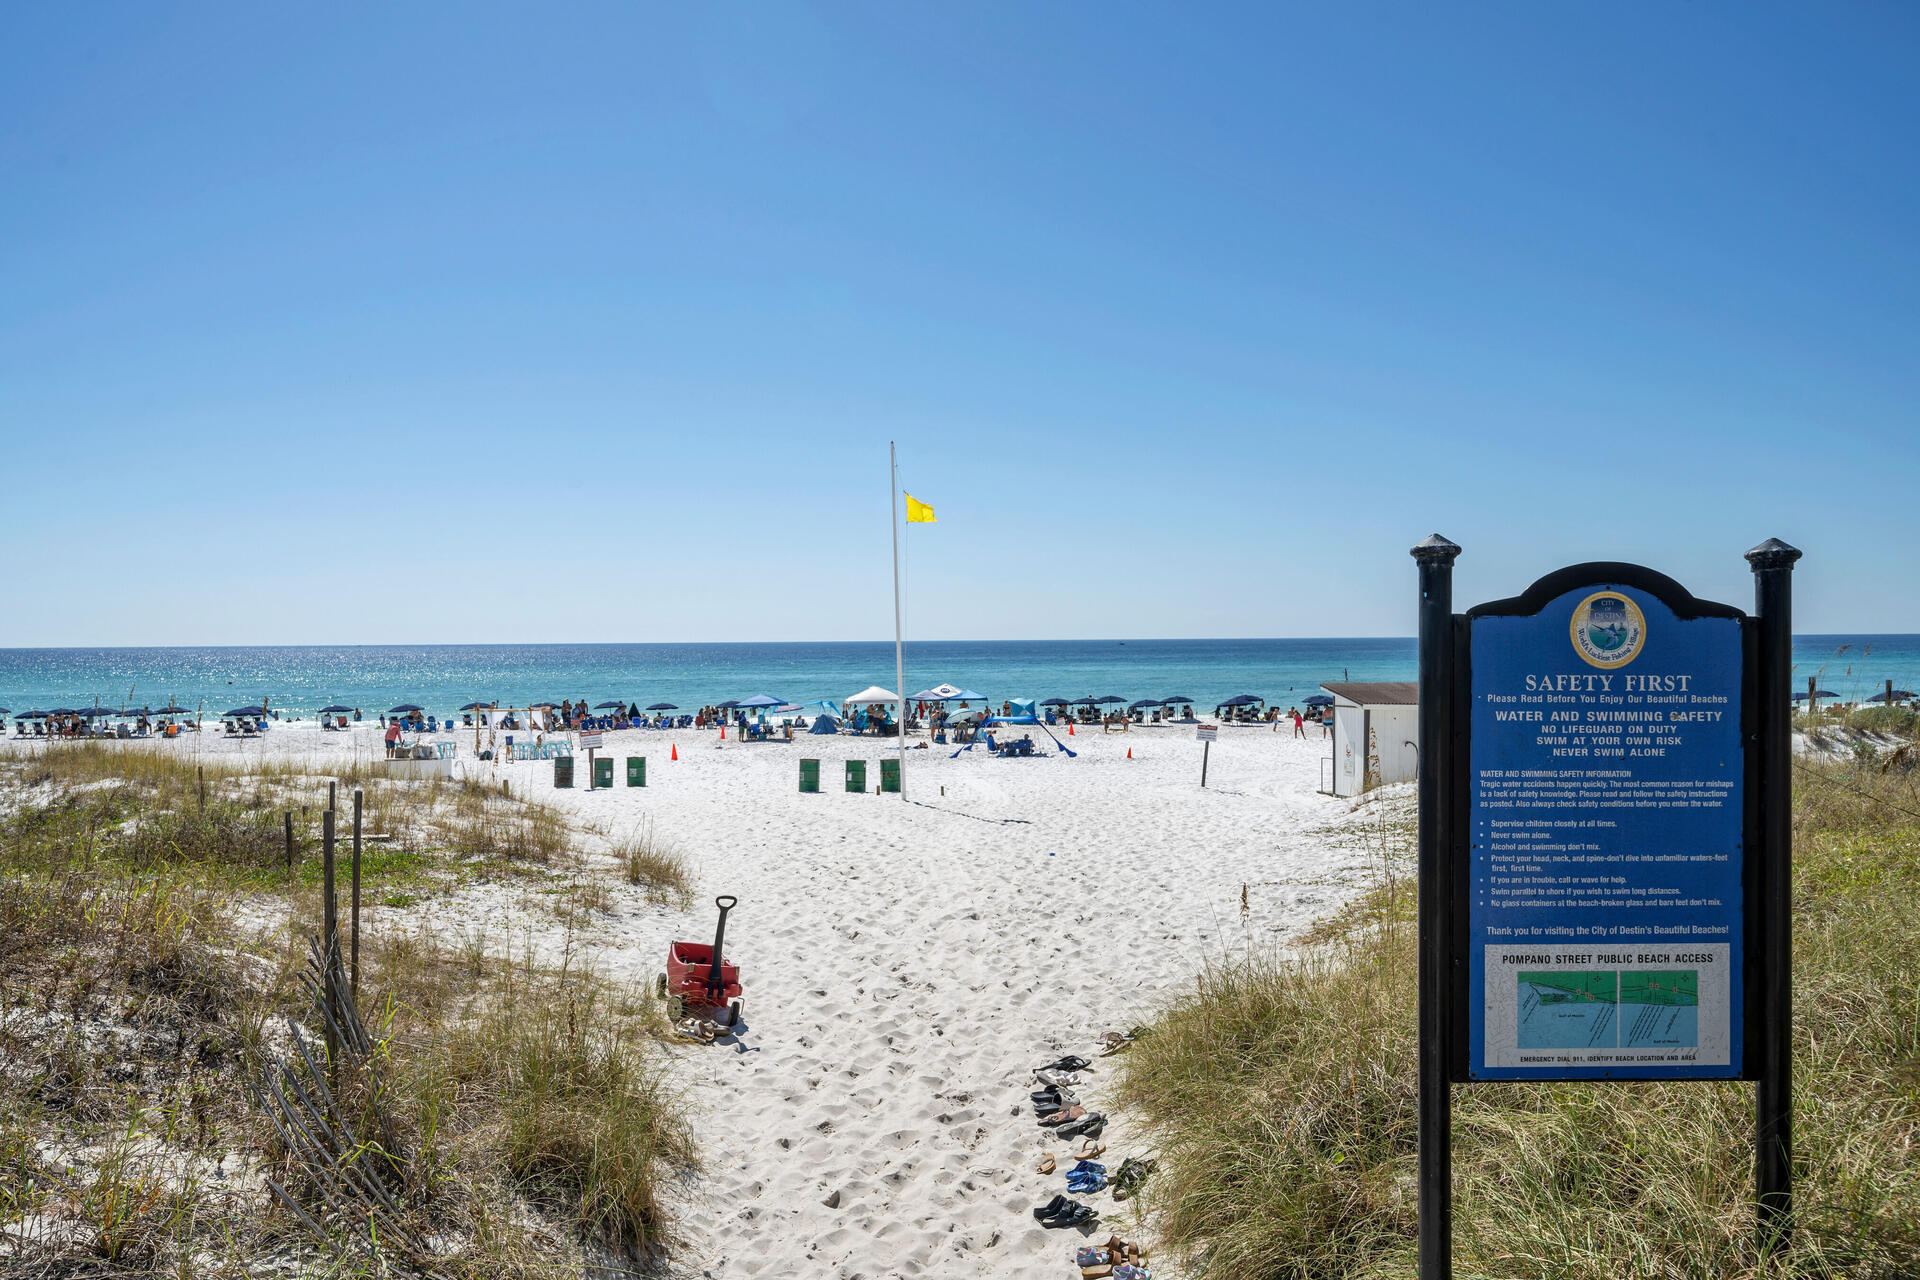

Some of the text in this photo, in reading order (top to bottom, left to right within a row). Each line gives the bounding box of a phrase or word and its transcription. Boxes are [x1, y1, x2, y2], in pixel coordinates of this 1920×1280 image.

[1526, 675, 1691, 691] SAFETY FIRST
[1488, 694, 1727, 704] Please Read Before You Enjoy Our Beautiful Beaches
[1496, 711, 1722, 721] WATER AND SWIMMING SAFETY
[1542, 725, 1556, 733] NO
[1591, 737, 1620, 745] YOUR
[1626, 737, 1650, 745] OWN
[1657, 737, 1681, 745] RISK
[1553, 748, 1665, 756] NEVER SWIM ALONE
[1505, 770, 1520, 778] AND
[1521, 770, 1558, 778] SWIMMING
[1559, 770, 1584, 778] SAFETY
[1586, 770, 1631, 778] INFORMATION
[1480, 780, 1501, 789] Tragic
[1502, 780, 1522, 788] water
[1523, 780, 1555, 788] accidents
[1557, 780, 1581, 789] happen
[1610, 780, 1622, 788] The
[1623, 780, 1640, 788] most
[1706, 780, 1734, 788] mishaps
[1493, 790, 1509, 798] lack
[1510, 790, 1517, 798] of
[1518, 790, 1538, 799] safety
[1603, 790, 1618, 798] read
[1633, 790, 1654, 798] follow
[1667, 790, 1687, 799] safety
[1516, 800, 1530, 808] Also
[1532, 800, 1555, 808] always
[1557, 800, 1577, 808] check
[1578, 800, 1598, 808] safety
[1491, 819, 1524, 828] Supervise
[1554, 820, 1577, 828] closely
[1491, 831, 1511, 839] Never
[1531, 843, 1566, 852] swimming
[1491, 854, 1515, 862] Protect
[1572, 854, 1585, 862] and
[1641, 854, 1654, 862] into
[1491, 876, 1496, 884] If
[1497, 877, 1510, 885] you
[1491, 888, 1510, 896] Swim
[1511, 888, 1537, 897] parallel
[1587, 887, 1603, 895] wish
[1632, 888, 1646, 896] long
[1491, 899, 1501, 907] No
[1501, 899, 1520, 909] glass
[1521, 899, 1556, 907] containers
[1626, 899, 1644, 908] glass
[1486, 926, 1728, 936] Thank you for visiting the City of Destin's Beautiful Beaches!
[1503, 954, 1713, 964] POMPANO STREET PUBLIC BEACH ACCESS
